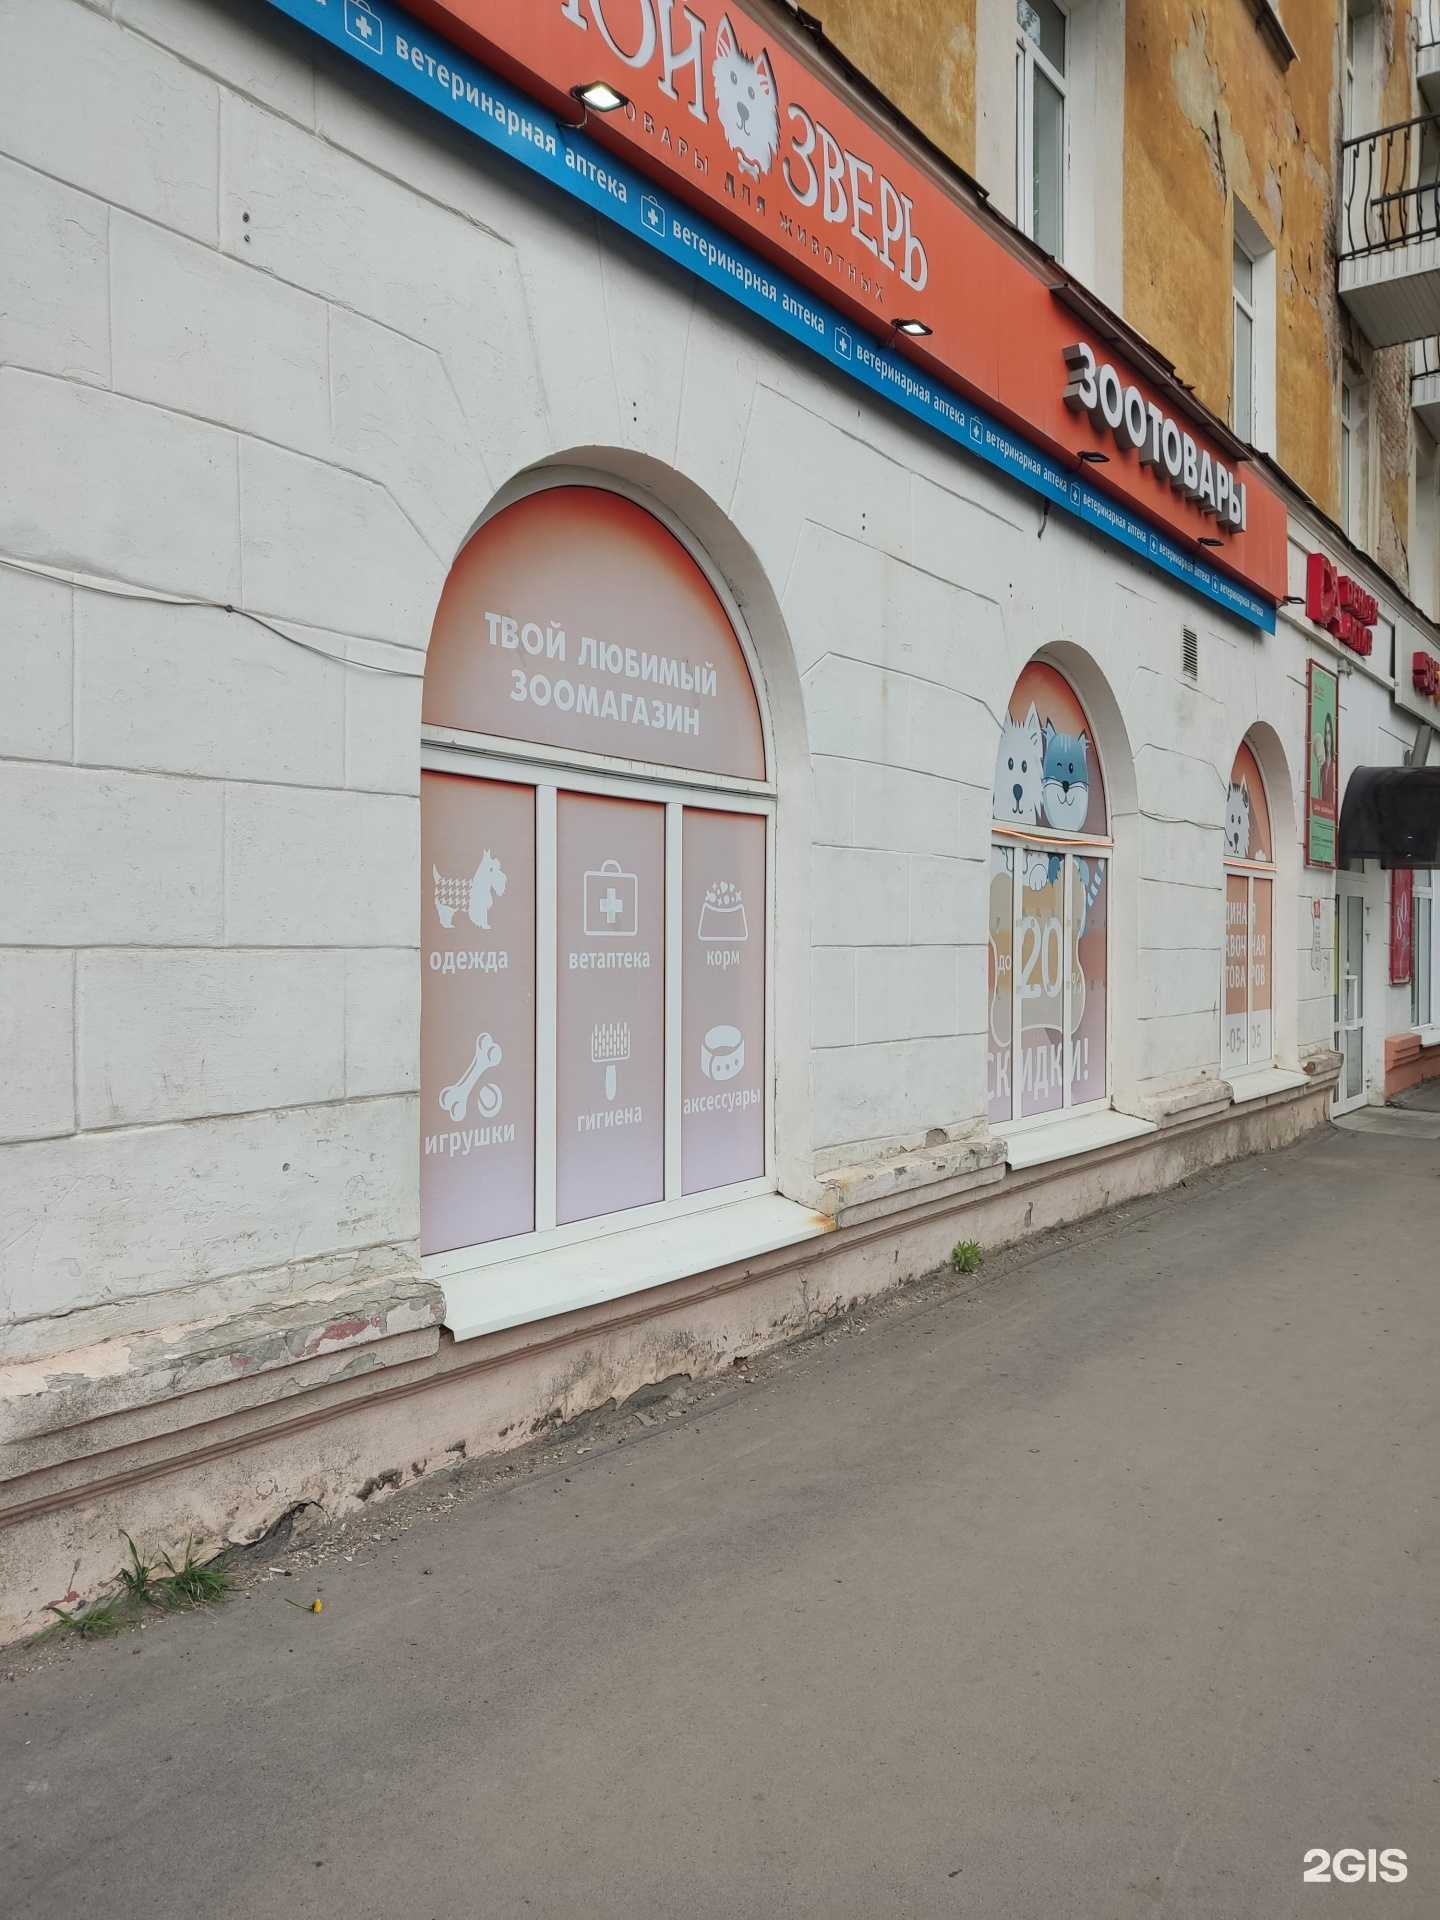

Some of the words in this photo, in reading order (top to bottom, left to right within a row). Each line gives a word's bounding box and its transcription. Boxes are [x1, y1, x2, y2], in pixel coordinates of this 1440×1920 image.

[395, 35, 556, 156] ветеринарная
[565, 146, 628, 204] аптека
[623, 101, 709, 177] ОВАРЫ
[724, 172, 767, 217] ДЛЯ
[779, 211, 887, 304] ЖИВОТНЫХ
[782, 102, 928, 292] ЗВЕРЬ
[672, 218, 777, 303] ветеринарная
[781, 293, 825, 336] аптека
[856, 345, 930, 404] ветеринарная
[933, 395, 966, 427] аптека
[985, 429, 1041, 476] ветеринарная
[1043, 467, 1067, 492] аптека
[1063, 342, 1247, 533] ЗООТОВАРЫ
[1082, 493, 1126, 529] ветеринарная
[1127, 521, 1147, 543] аптека
[484, 611, 567, 662] ТВОЙ
[578, 636, 718, 697] ЛЮБИМЫЙ
[510, 669, 701, 737] ЗООМАГАЗИН
[429, 950, 509, 974] одежда
[568, 950, 651, 970] ветаптека
[706, 949, 741, 970] корм
[576, 1105, 643, 1133] гигиена
[683, 1087, 762, 1117] аксессуары
[425, 1122, 516, 1158] игрушки
